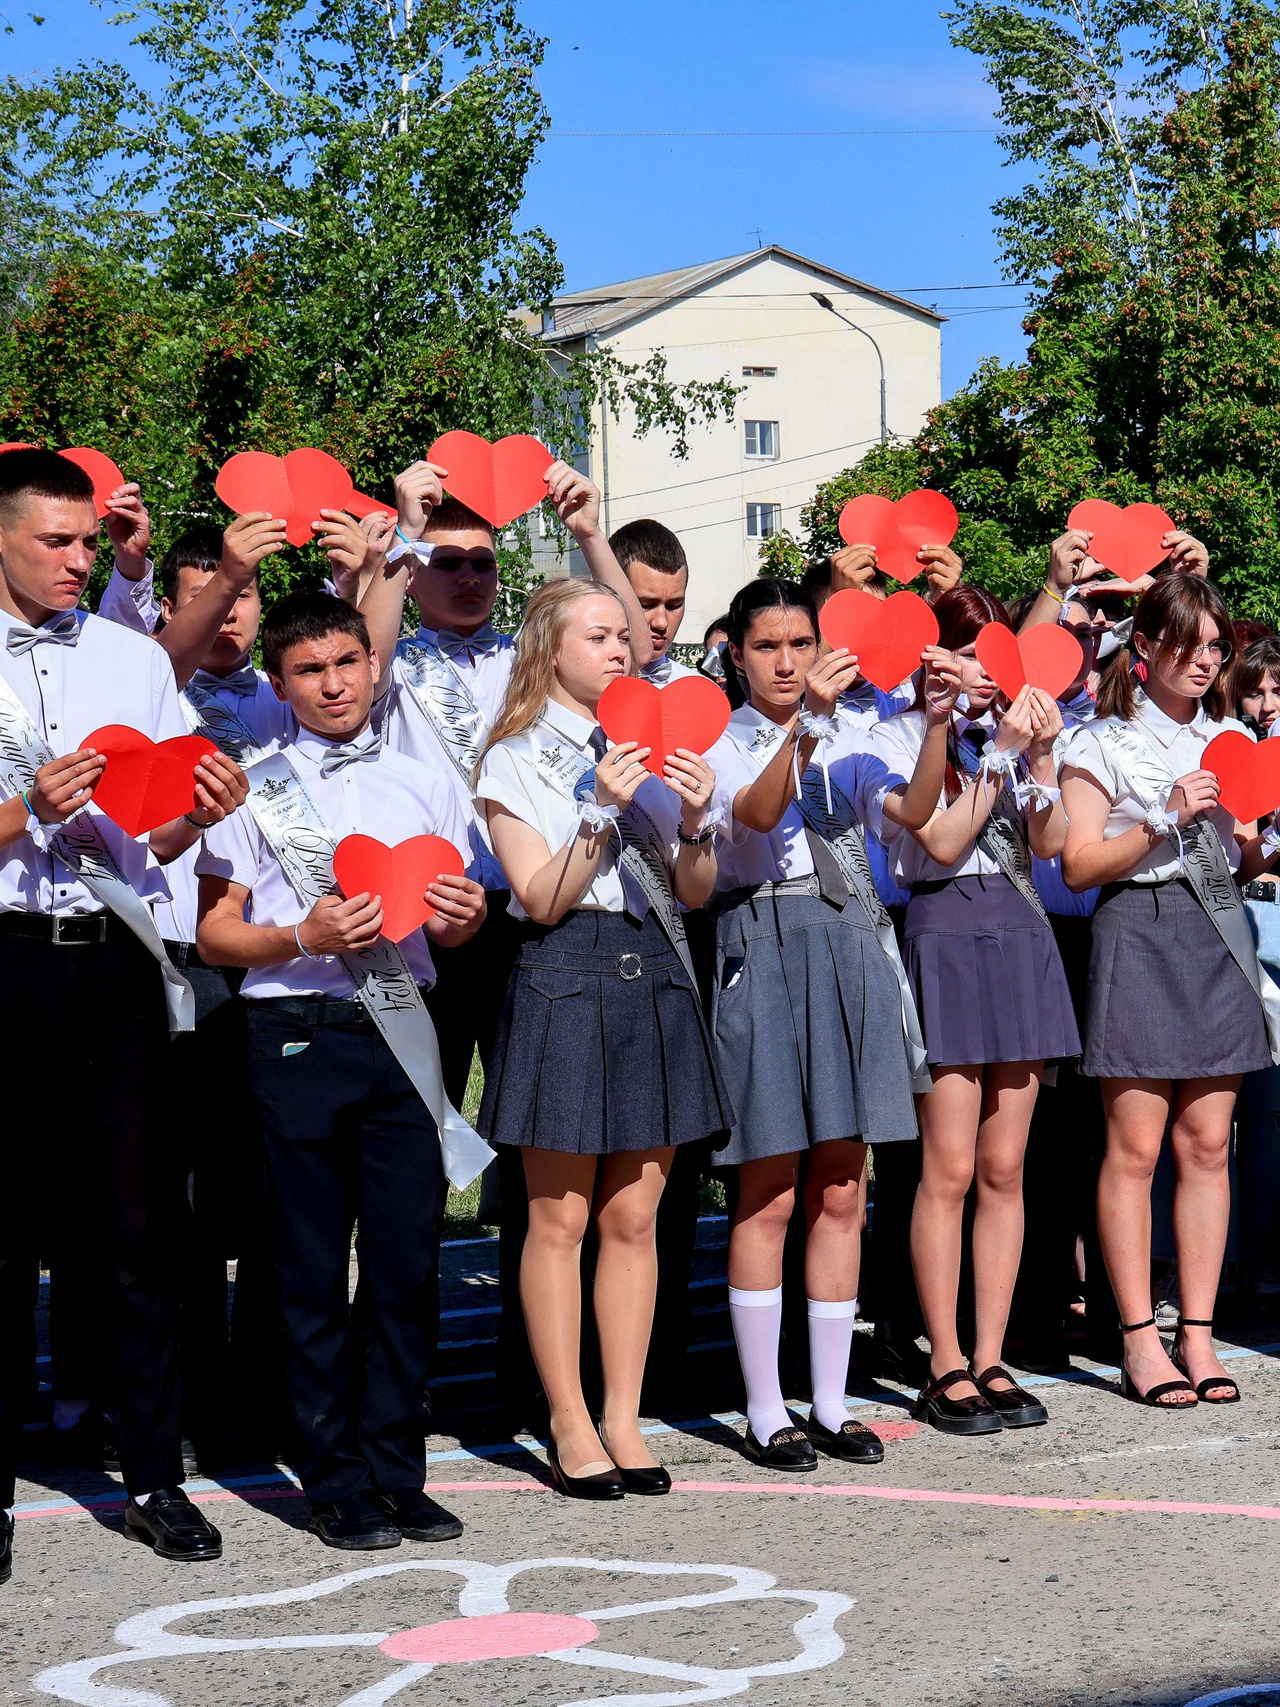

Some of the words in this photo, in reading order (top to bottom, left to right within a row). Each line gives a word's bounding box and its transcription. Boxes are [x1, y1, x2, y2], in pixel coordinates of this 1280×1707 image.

[426, 685, 479, 766] Выпуск
[60, 834, 118, 882] 2024
[1205, 875, 1238, 913] 2024
[367, 967, 417, 1013] 2024
